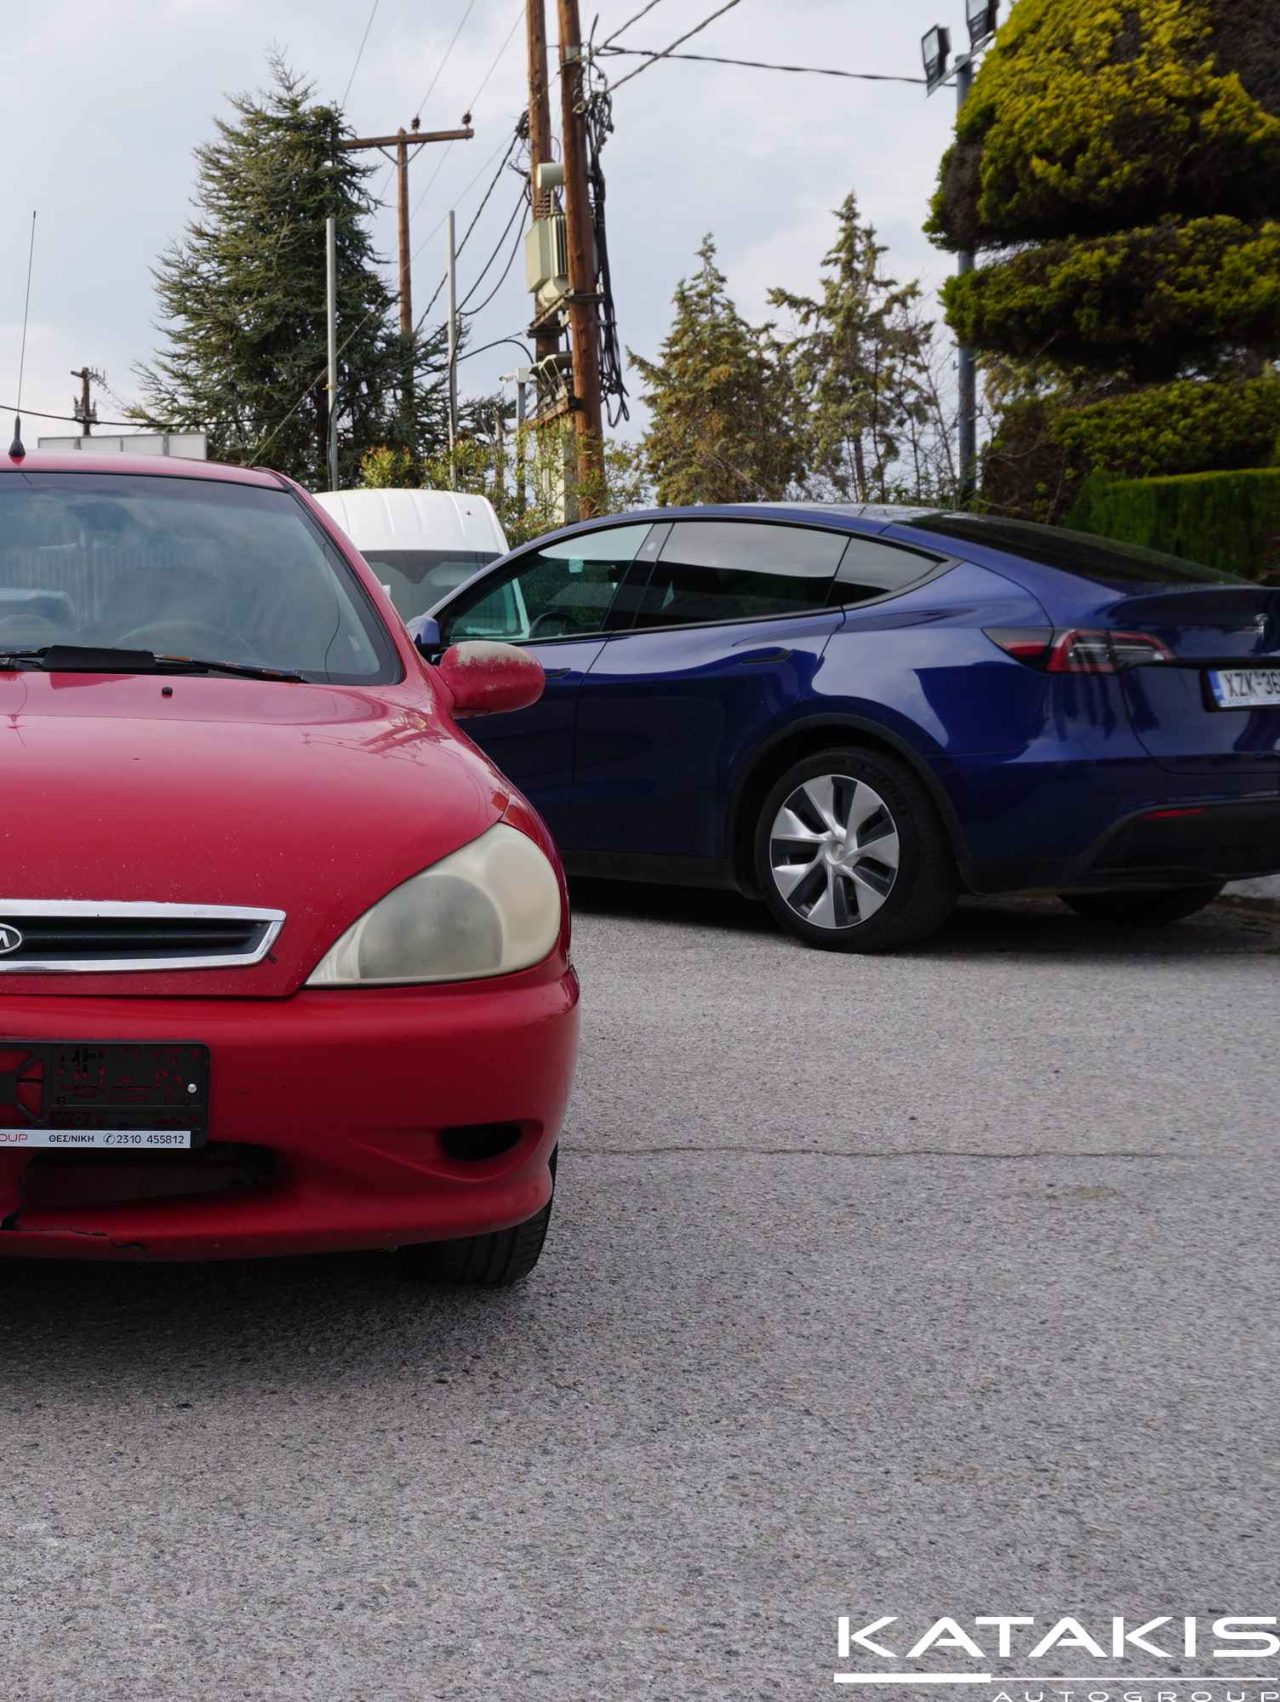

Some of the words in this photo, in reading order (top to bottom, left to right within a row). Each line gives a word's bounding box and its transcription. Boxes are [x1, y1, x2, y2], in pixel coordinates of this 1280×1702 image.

[1223, 671, 1280, 698] XZK-36
[117, 1134, 142, 1145] 2310
[146, 1134, 185, 1145] 455812
